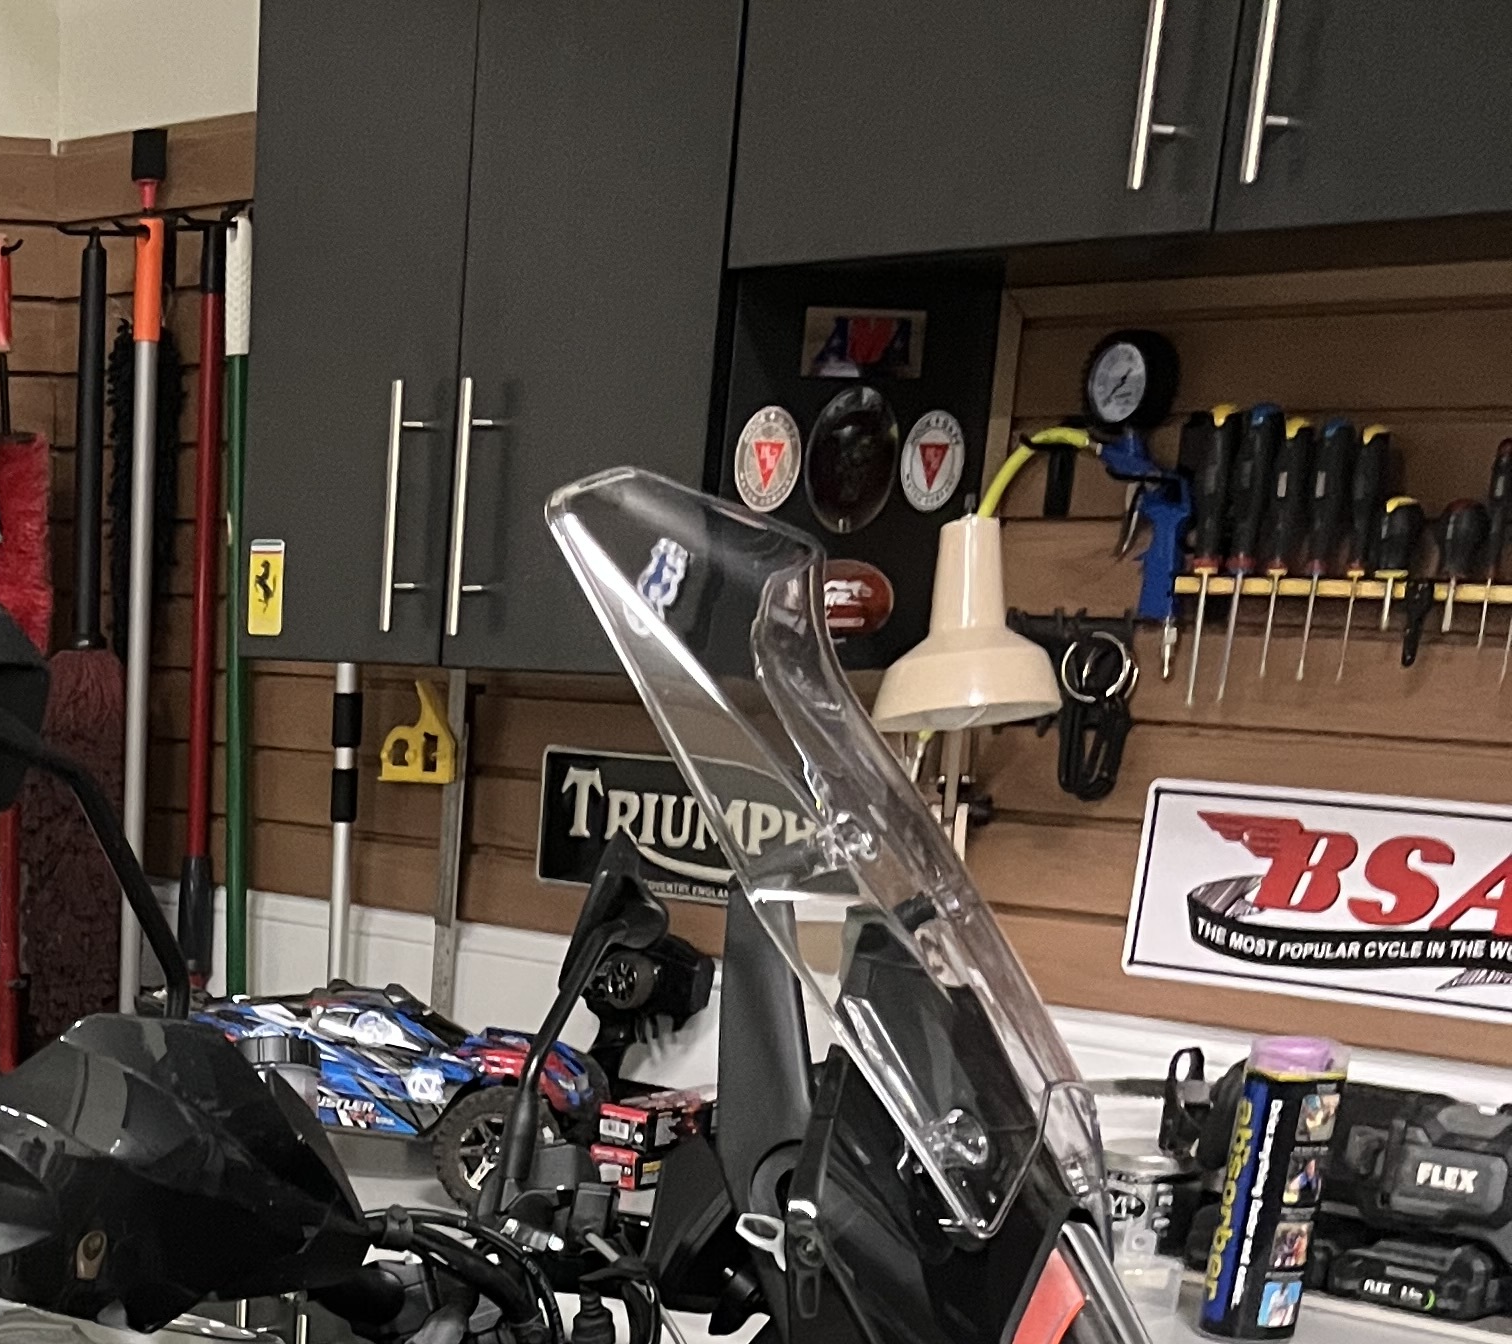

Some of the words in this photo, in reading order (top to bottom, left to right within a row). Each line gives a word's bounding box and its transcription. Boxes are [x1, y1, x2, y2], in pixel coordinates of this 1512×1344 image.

[561, 766, 818, 857] TRIUMPH
[1253, 820, 1512, 937] BSA
[1197, 917, 1226, 945] THE
[1229, 931, 1277, 958] MOST
[1279, 941, 1360, 960] POPULAR
[1364, 941, 1423, 959] CYCLE
[1426, 942, 1445, 959] IN
[1450, 939, 1486, 959] THE
[317, 1095, 375, 1113] USTLER
[1207, 1099, 1252, 1300] absorber
[1416, 1162, 1478, 1194] FLEX
